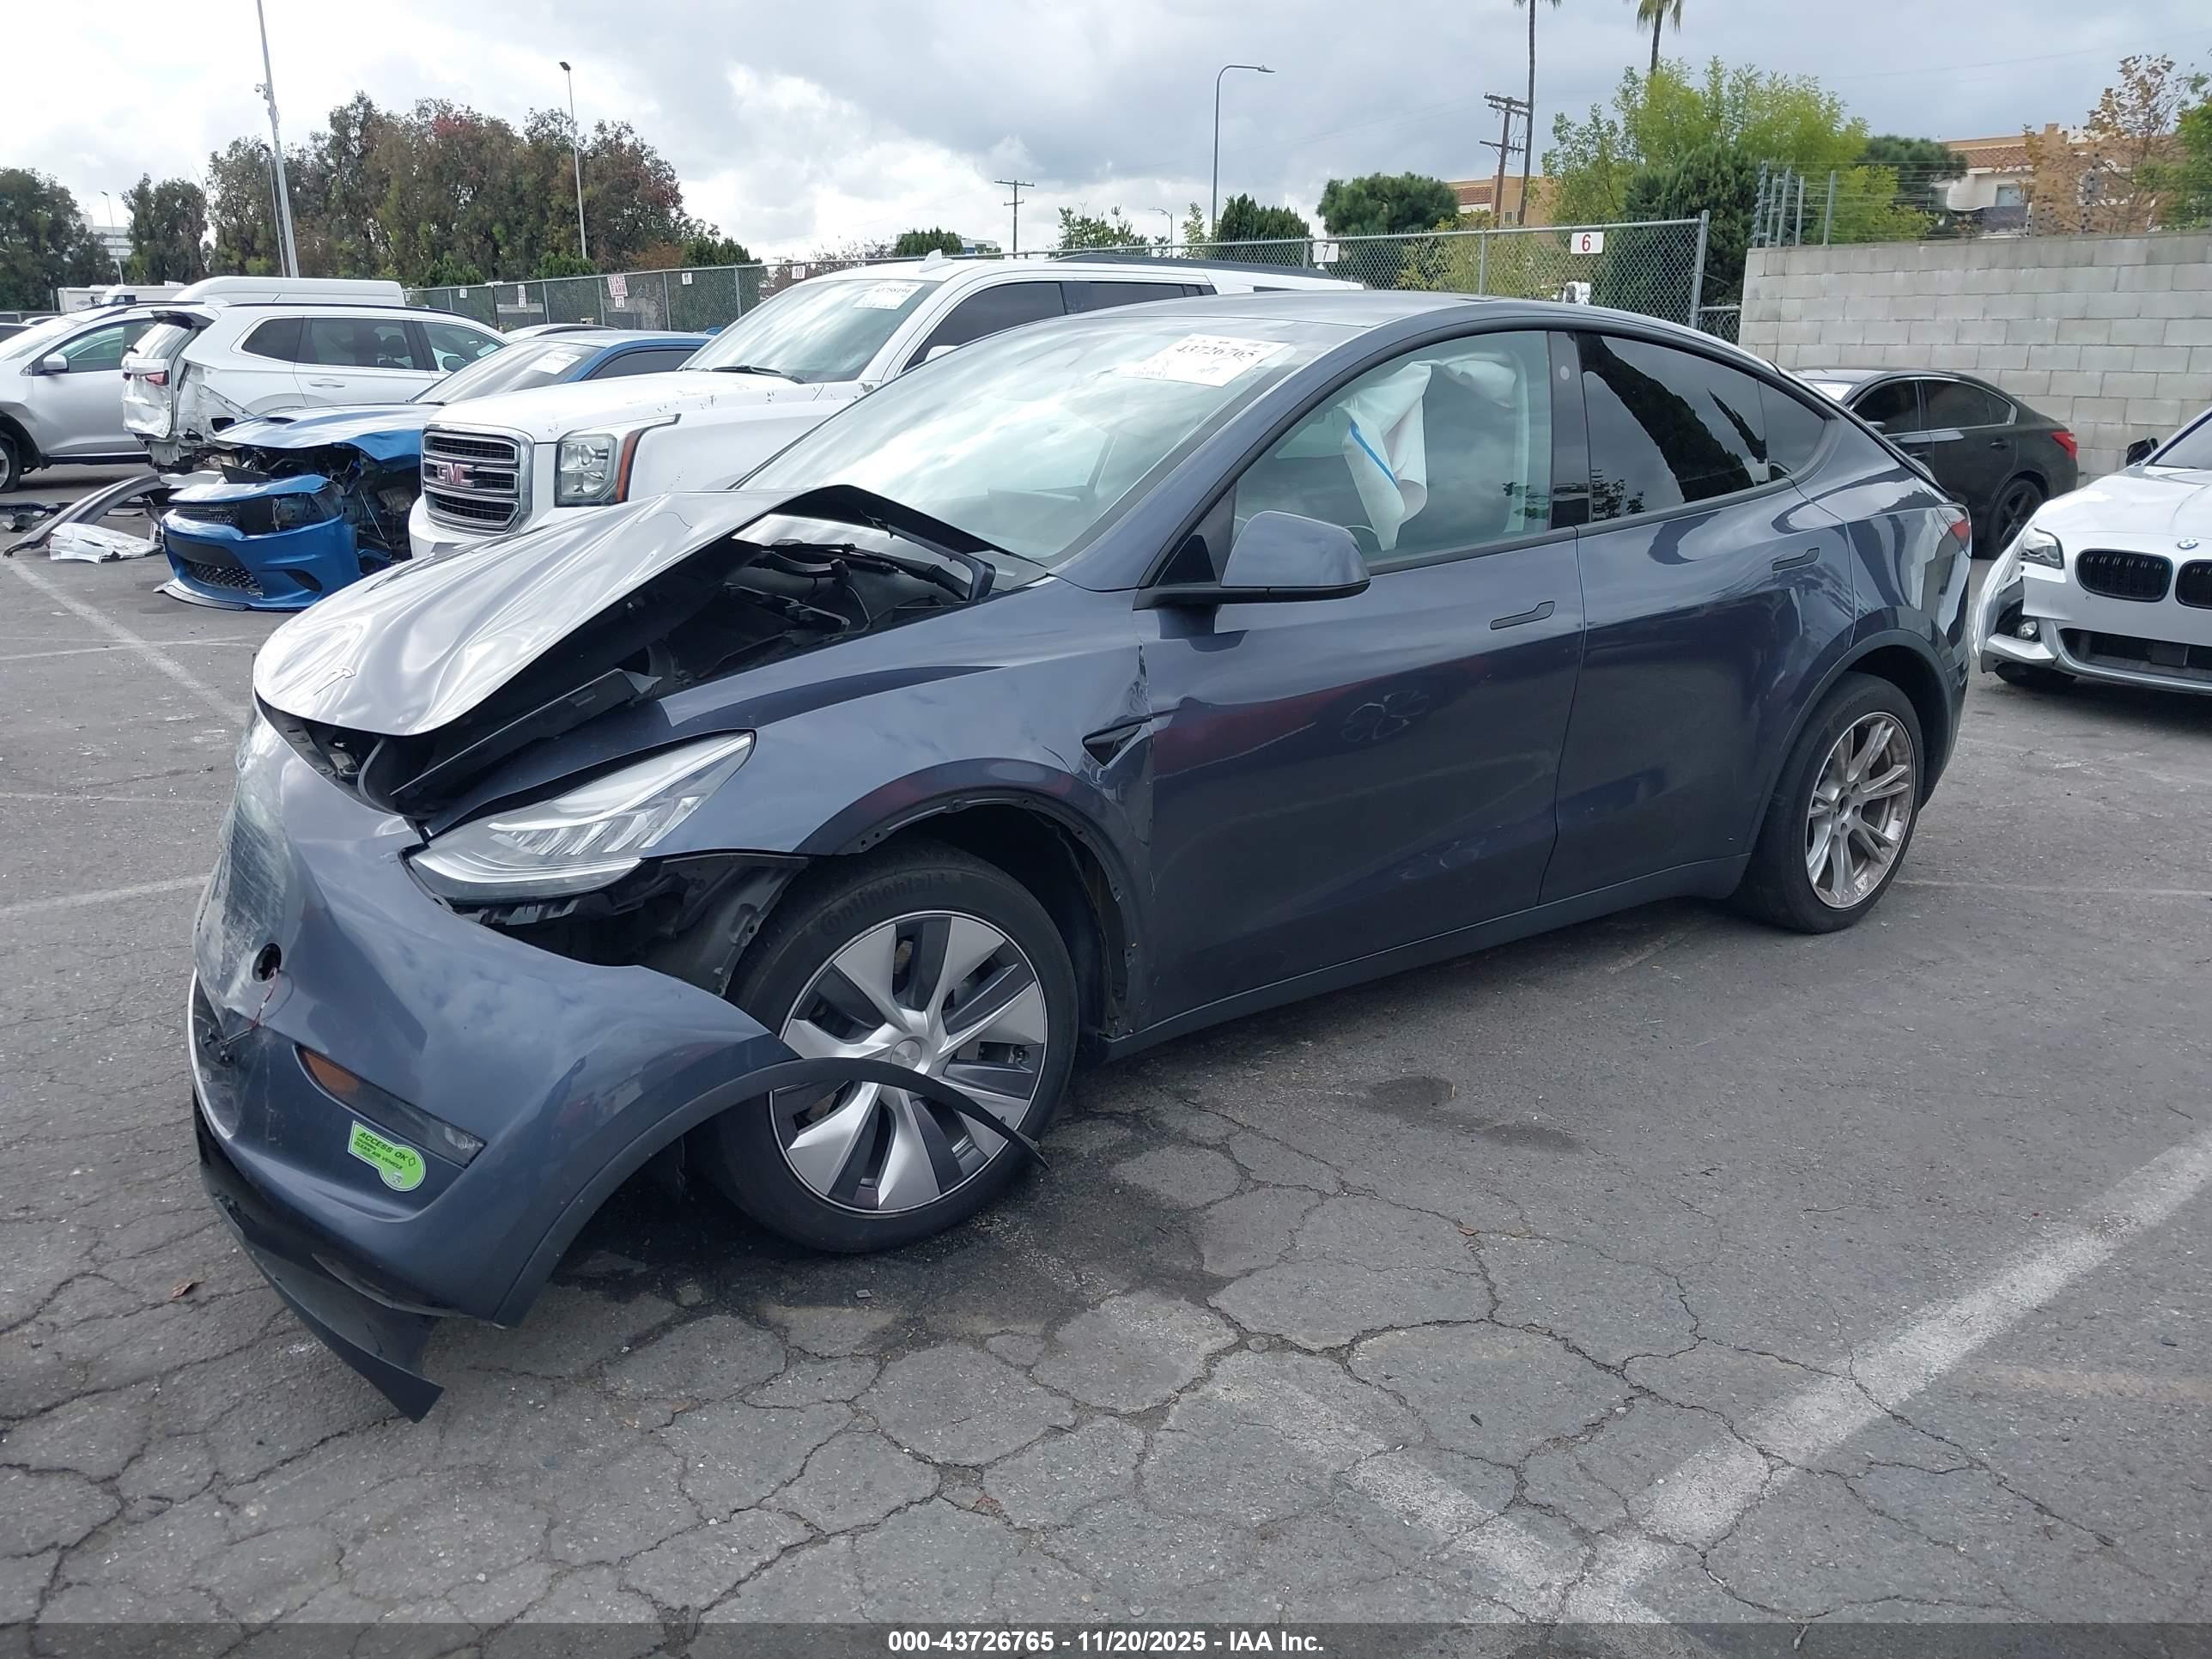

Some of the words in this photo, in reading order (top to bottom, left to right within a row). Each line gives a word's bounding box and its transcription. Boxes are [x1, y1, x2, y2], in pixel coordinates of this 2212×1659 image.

[1582, 234, 1591, 252] 6
[1322, 245, 1330, 261] 7
[795, 266, 803, 278] 10
[608, 276, 625, 286] STATE
[611, 284, 626, 295] FARM
[617, 297, 623, 307] 12
[436, 464, 475, 488] GMC
[358, 1133, 393, 1153] ACCESS
[394, 1152, 409, 1162] OK
